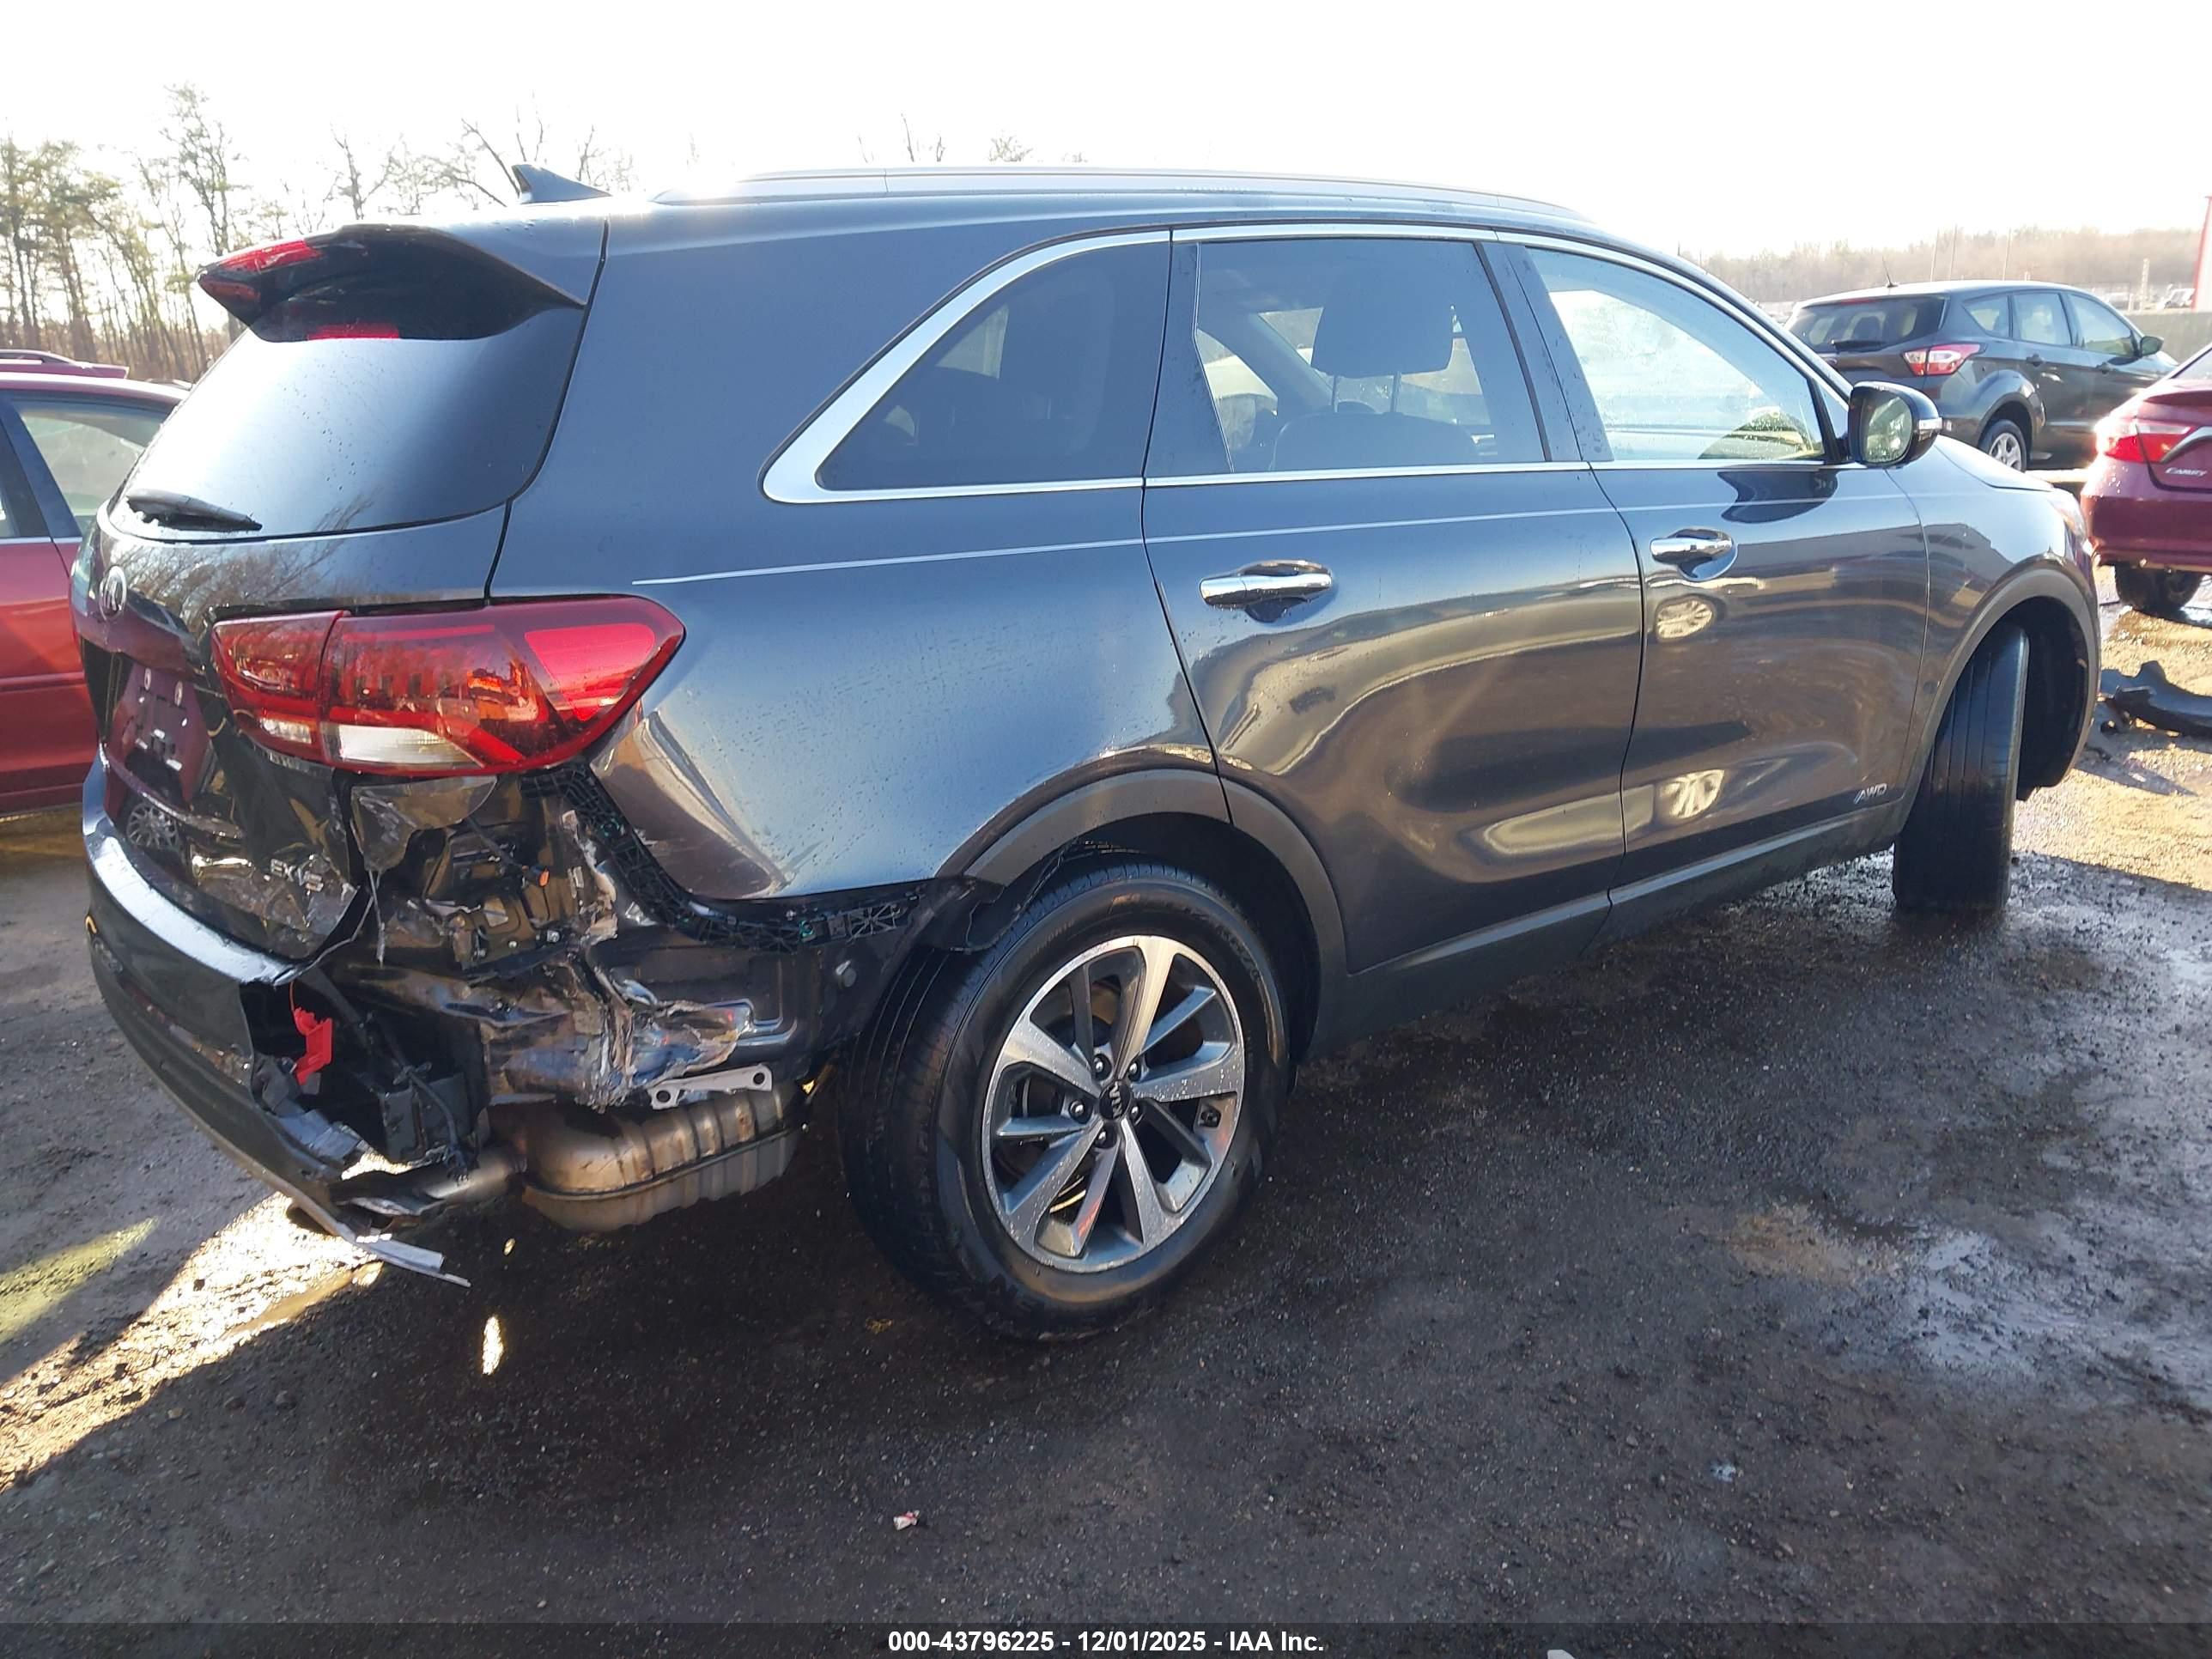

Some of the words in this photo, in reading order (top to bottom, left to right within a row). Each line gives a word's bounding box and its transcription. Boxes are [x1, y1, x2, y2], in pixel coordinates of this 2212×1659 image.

[1853, 782, 1888, 804] AWD
[270, 859, 295, 882] EX
[297, 866, 324, 891] V6
